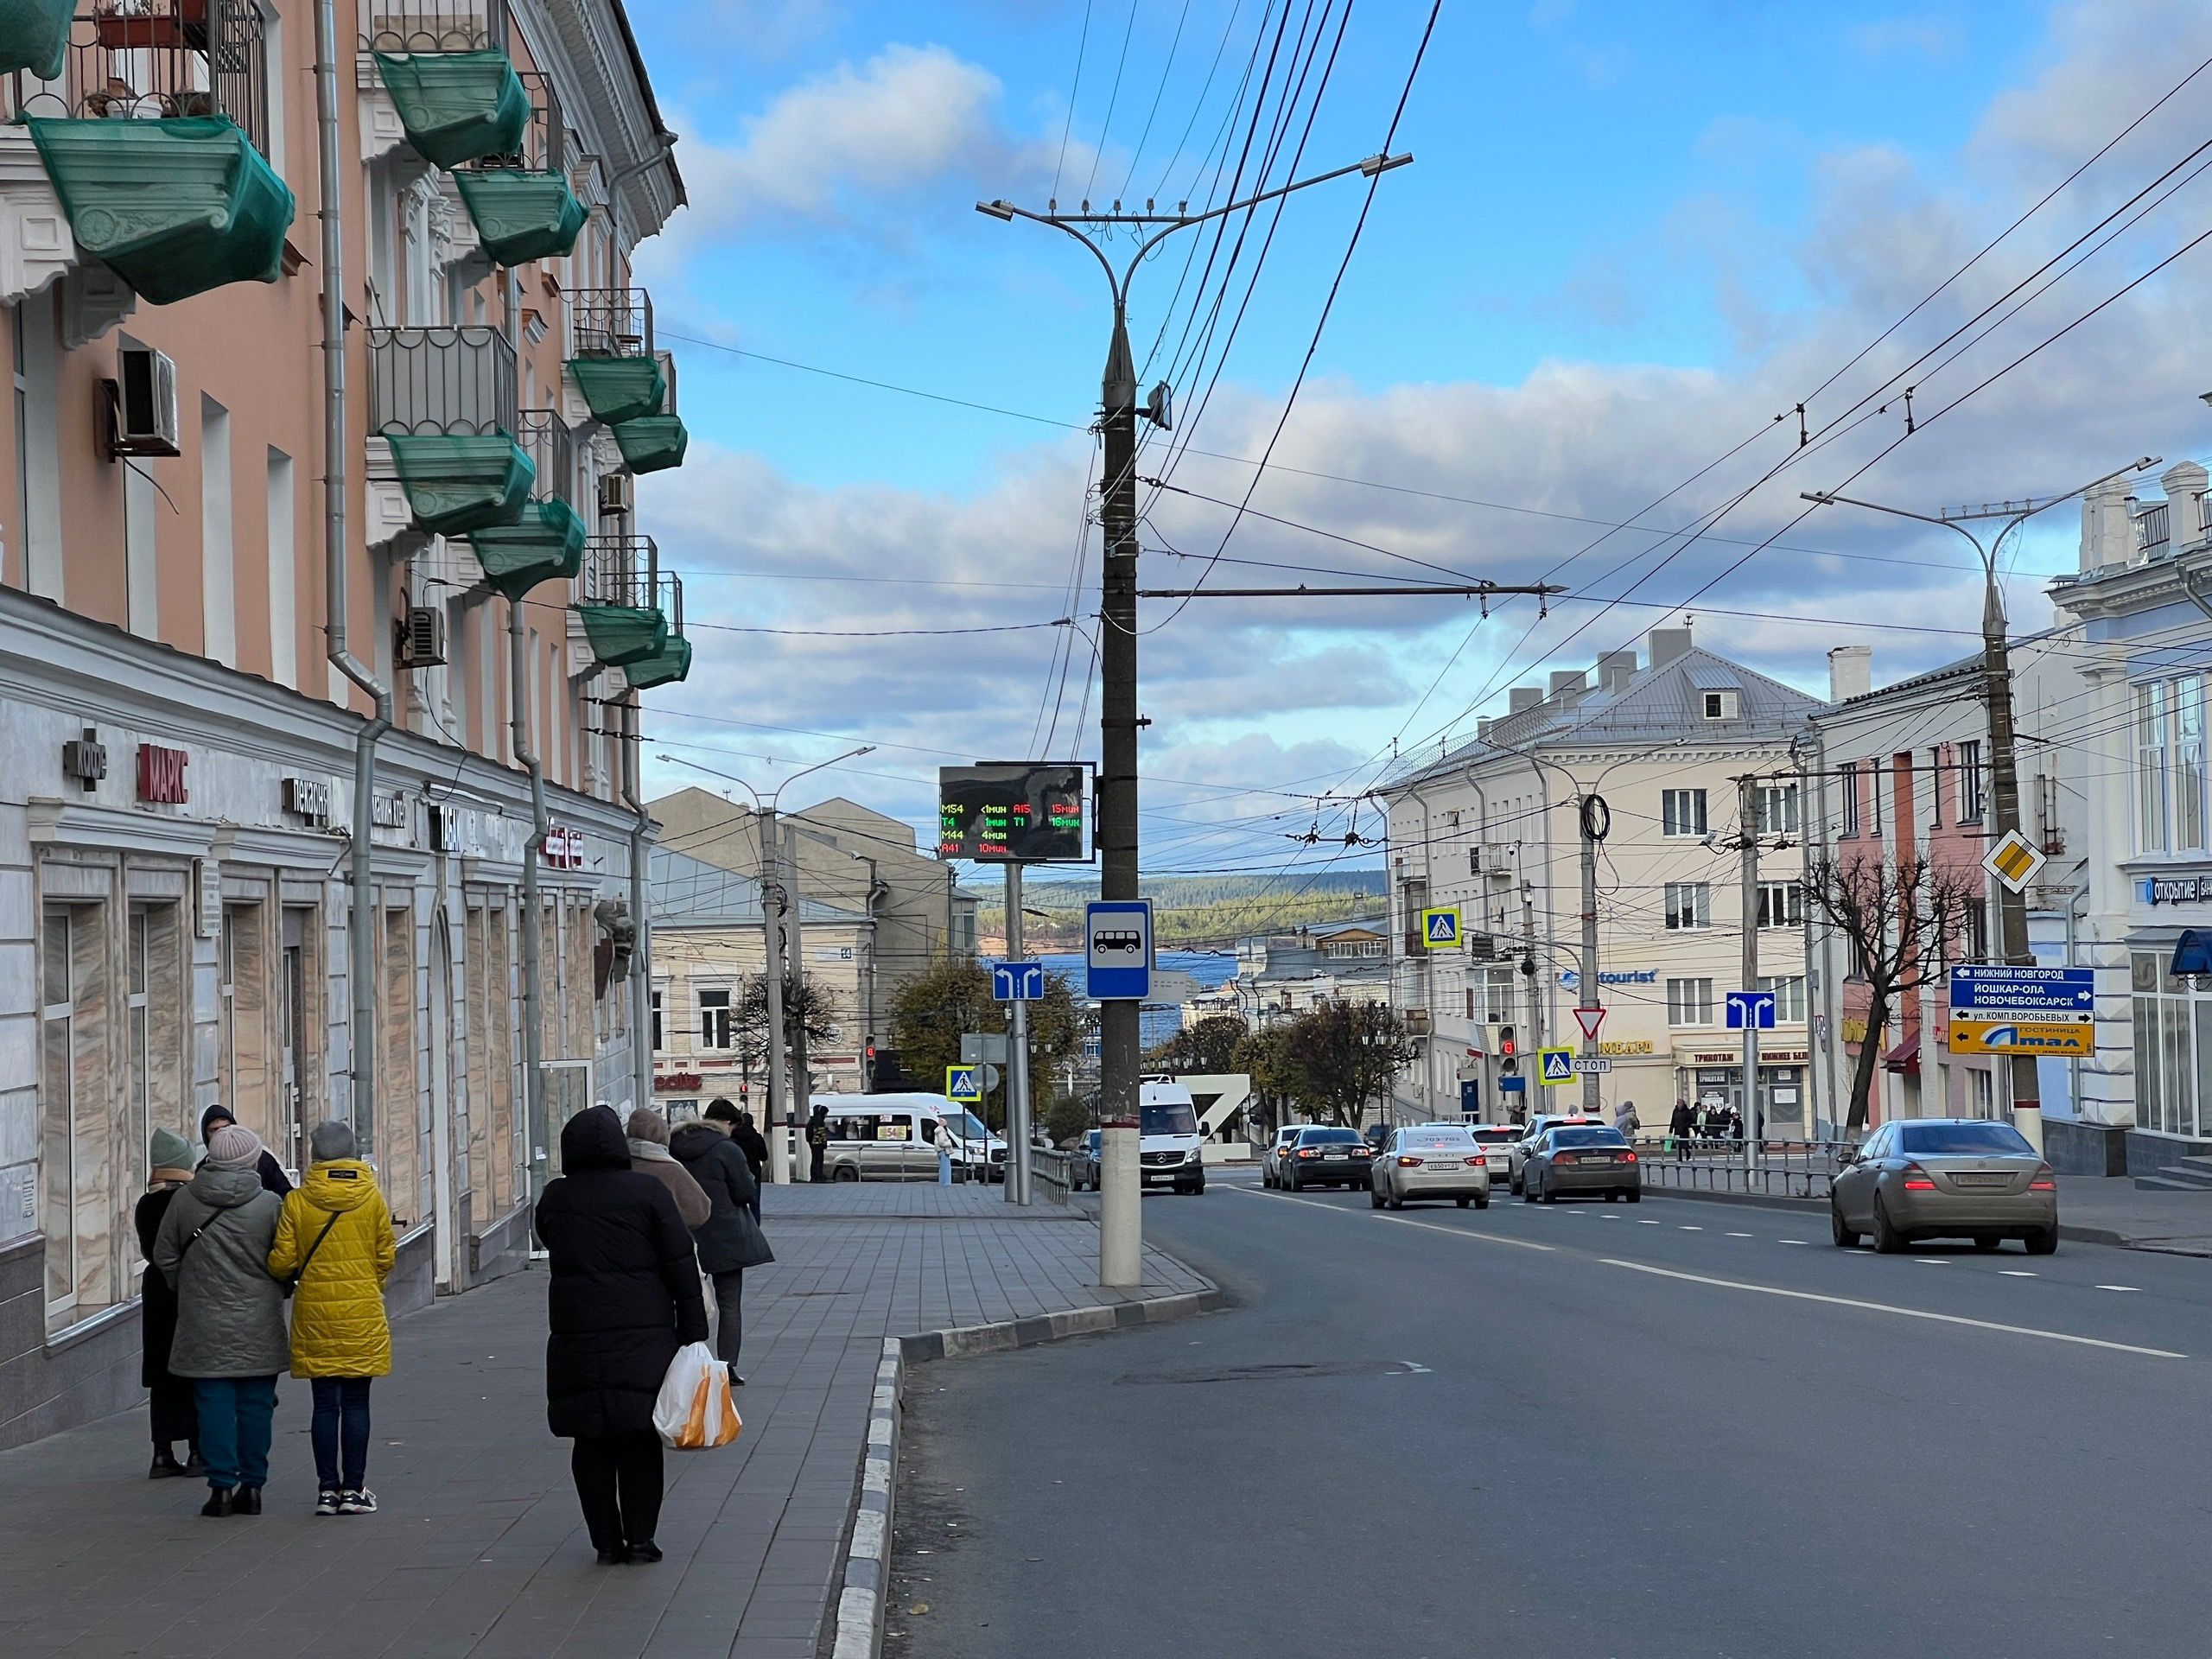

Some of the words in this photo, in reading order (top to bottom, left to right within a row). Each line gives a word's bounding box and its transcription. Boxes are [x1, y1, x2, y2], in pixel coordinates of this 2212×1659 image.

[149, 744, 189, 804] МАРКС
[293, 779, 328, 816] пекарня
[941, 804, 963, 814] М54
[941, 830, 963, 840] М44
[1974, 968, 2012, 978] НИЖНИЙ
[2014, 969, 2064, 981] НОВГОРОД
[1974, 982, 2045, 995] ЙОШКАР-ОЛА
[1974, 995, 2074, 1007] НОВОЧЕБОКСАРСК
[1974, 1013, 1985, 1021] ул.
[1600, 1040, 1653, 1054] МБАРД
[1694, 1053, 1734, 1063] ТРИКОТАЖ
[1761, 1052, 1791, 1061] НИЖНЕЕ
[1574, 1060, 1606, 1071] СТОП
